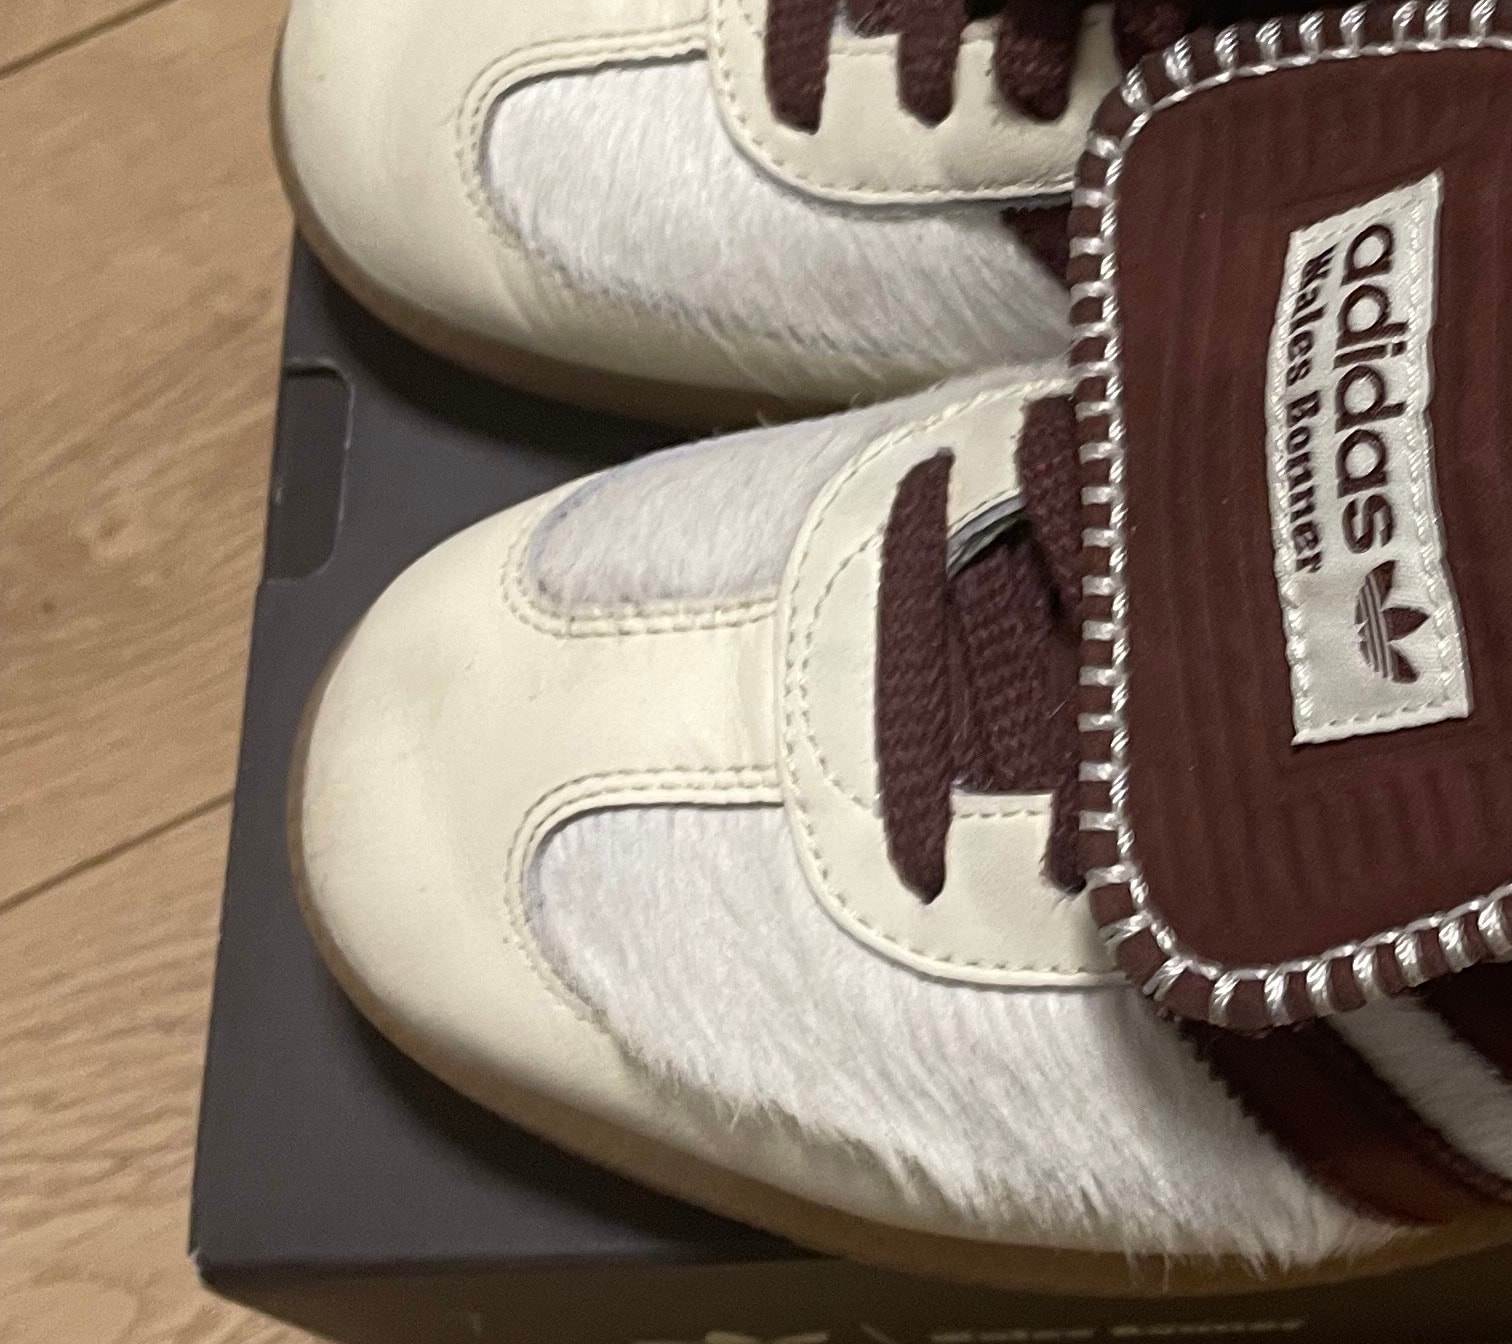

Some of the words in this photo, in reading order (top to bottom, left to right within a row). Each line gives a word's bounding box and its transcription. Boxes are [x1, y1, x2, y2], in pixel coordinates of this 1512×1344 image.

[1286, 246, 1336, 387] Wales
[1334, 222, 1408, 555] adidas
[1286, 387, 1322, 574] Bonner
